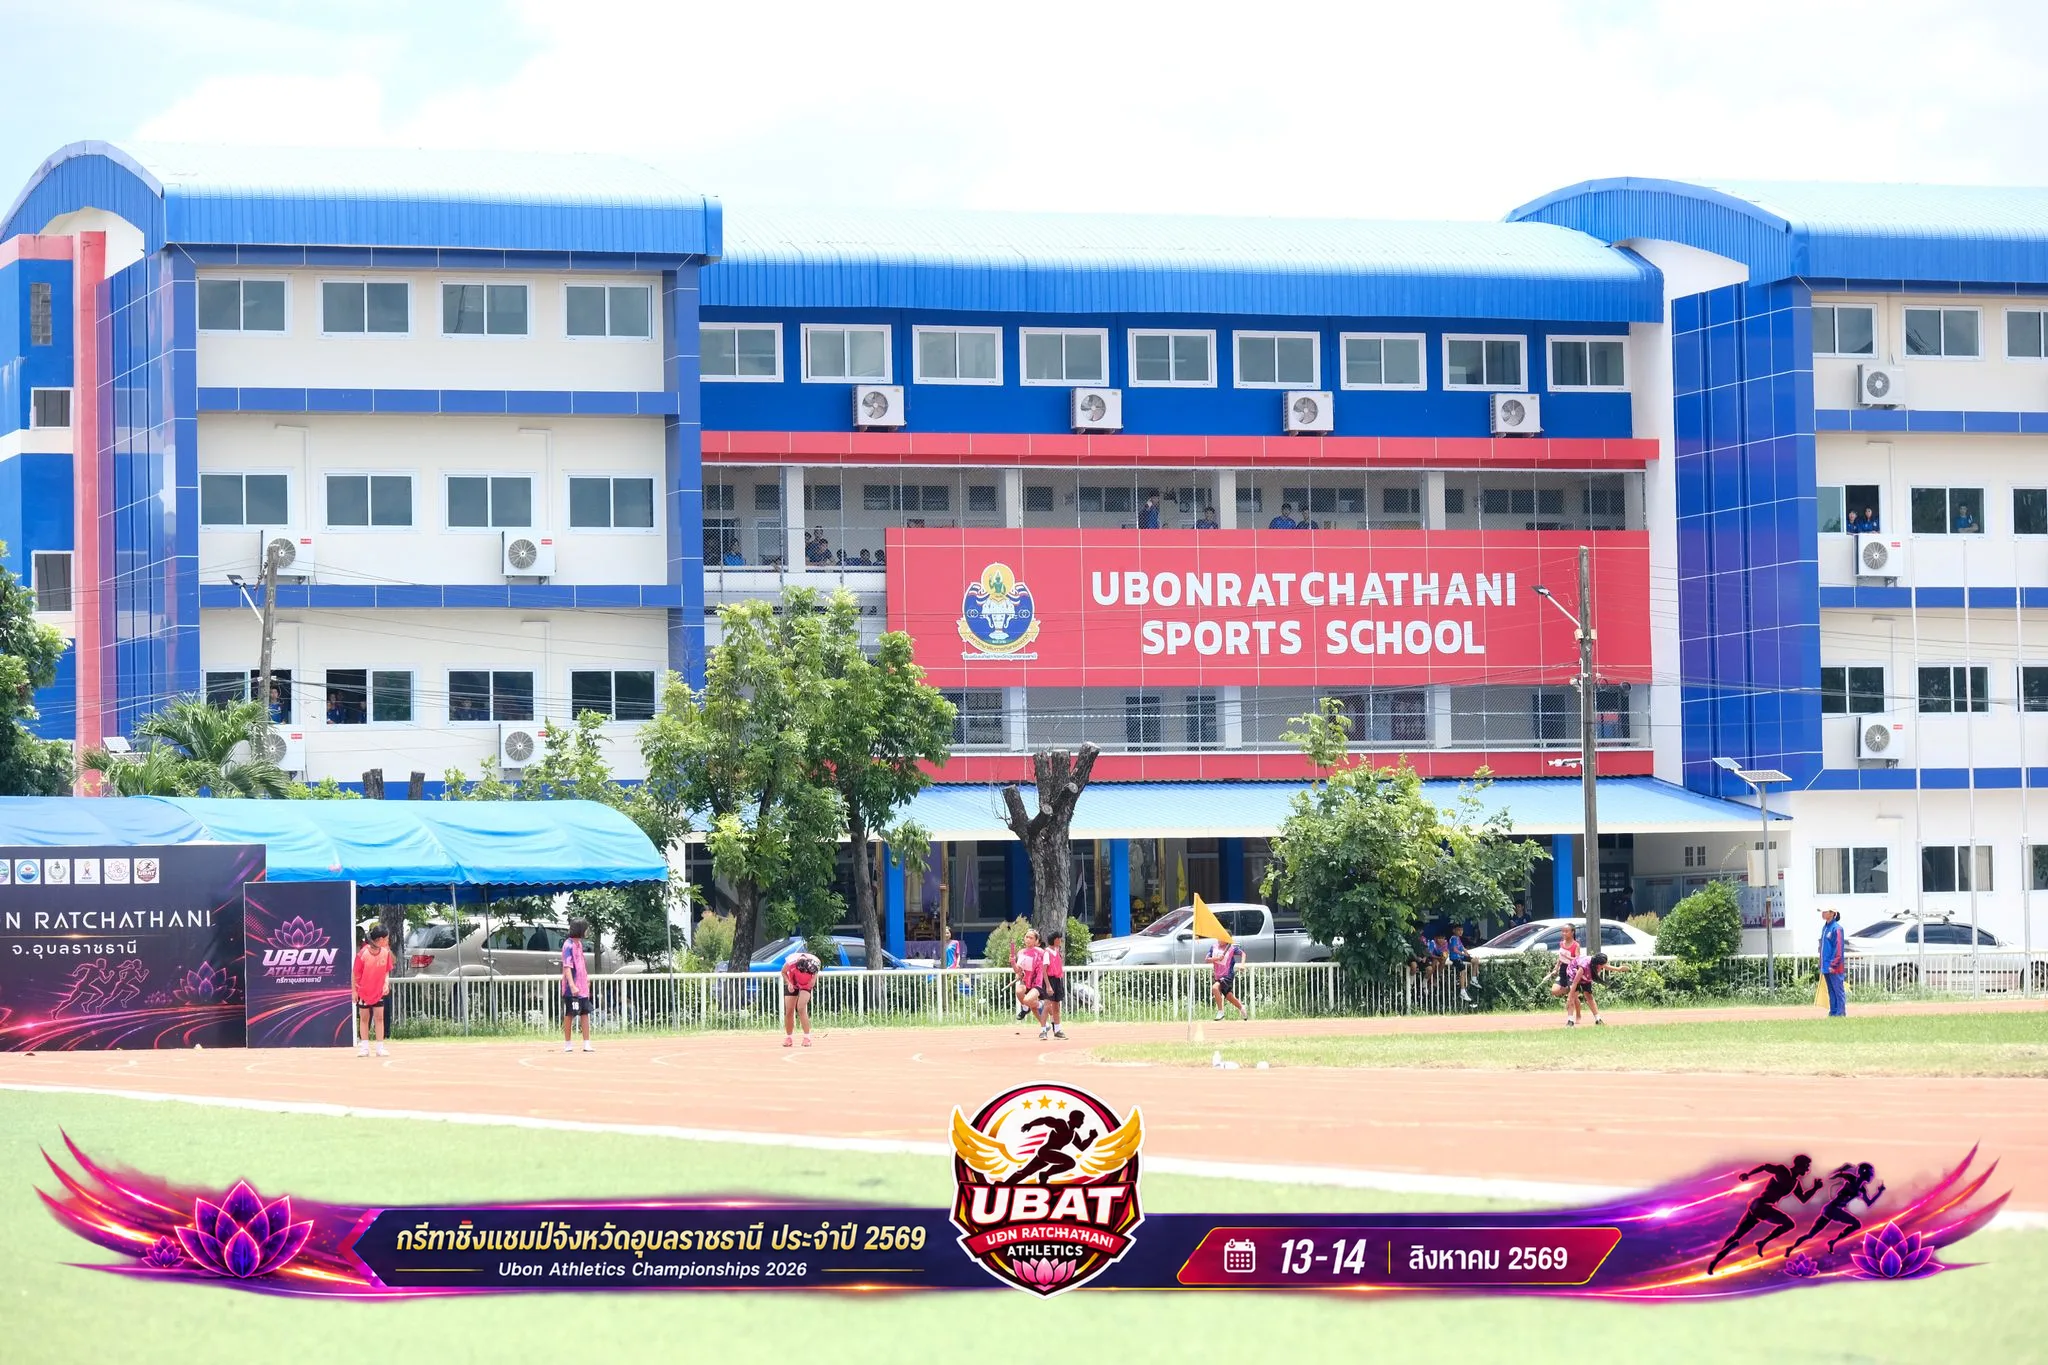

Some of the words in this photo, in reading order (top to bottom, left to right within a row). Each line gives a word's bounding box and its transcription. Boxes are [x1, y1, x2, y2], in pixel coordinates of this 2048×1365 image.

[1091, 571, 1516, 607] UBONRATCHATHANI
[1142, 620, 1302, 655] SPORTS
[1326, 620, 1485, 655] SCHOOL
[34, 910, 211, 930] RATCHATHANI
[12, 940, 137, 960] จ.อุบลราชธานี
[262, 948, 339, 966] UBON
[264, 965, 335, 977] ATHLETICS
